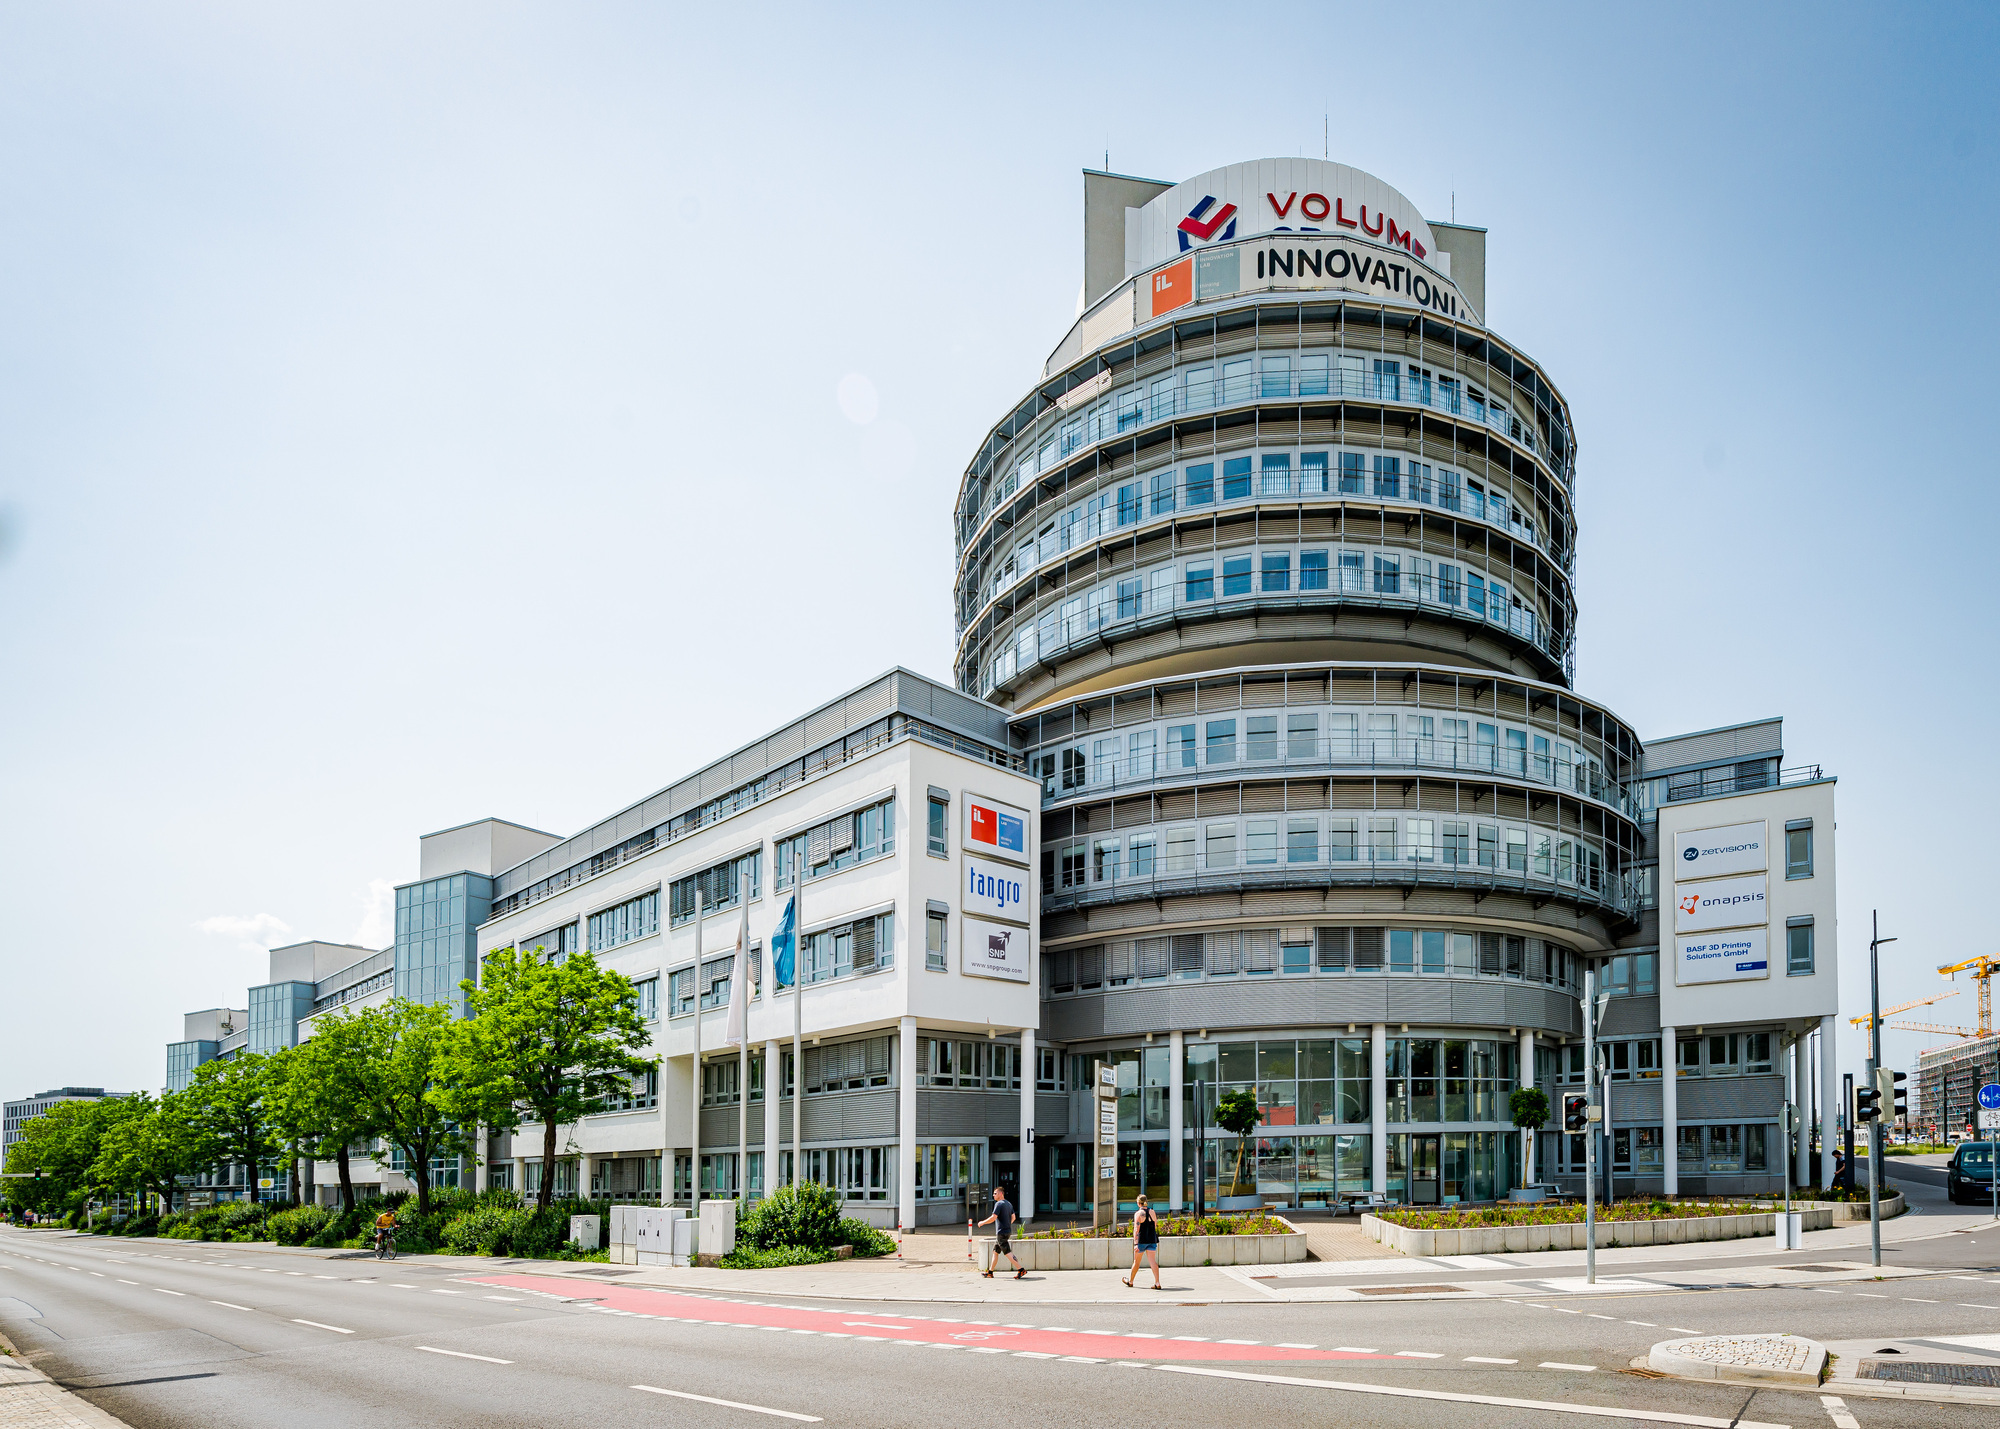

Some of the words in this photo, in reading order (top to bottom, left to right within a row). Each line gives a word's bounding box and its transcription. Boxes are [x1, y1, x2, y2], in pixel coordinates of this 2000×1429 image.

[1199, 252, 1235, 262] INNOVATION
[1701, 842, 1759, 856] zetvisions
[1702, 892, 1765, 907] onapsis
[989, 948, 1005, 959] SNP
[1686, 945, 1707, 953] BASF
[1721, 941, 1752, 950] Printing
[1686, 952, 1722, 961] Solutions
[1723, 948, 1749, 957] GmbH
[971, 961, 1023, 974] www.snpgroup.com
